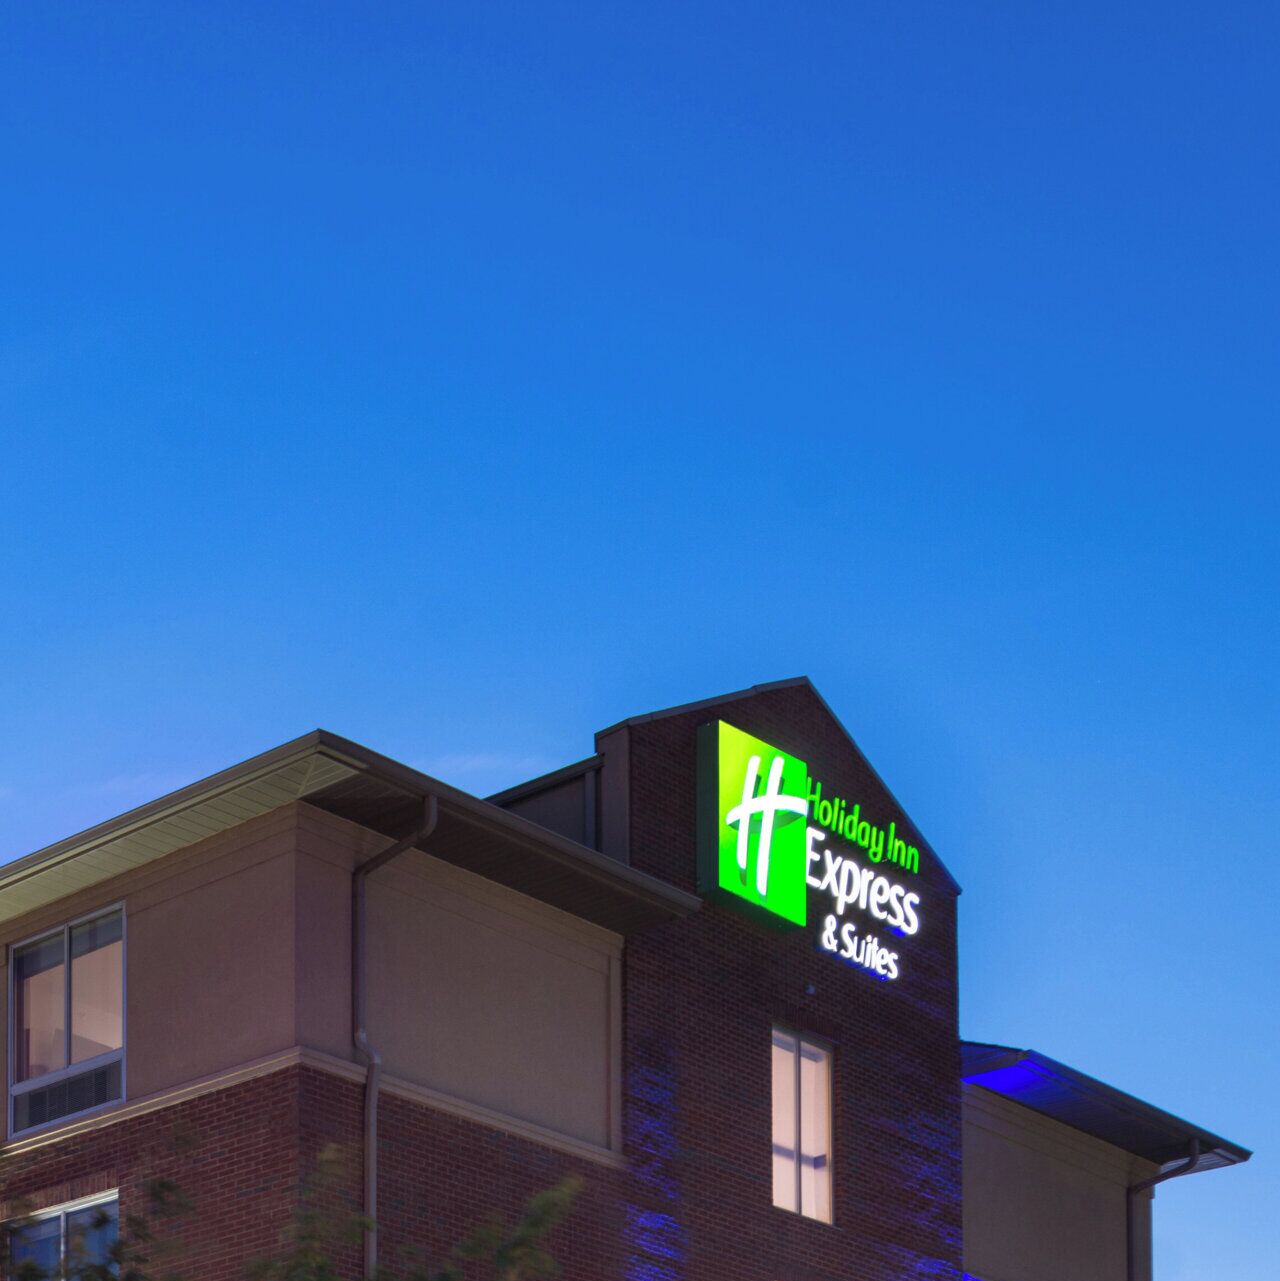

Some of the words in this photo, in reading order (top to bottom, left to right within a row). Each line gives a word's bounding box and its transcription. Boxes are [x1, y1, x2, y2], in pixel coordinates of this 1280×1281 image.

[807, 776, 884, 863] Holiday
[887, 822, 920, 874] Inn
[806, 827, 920, 936] Express
[822, 914, 838, 952] &
[841, 923, 899, 980] Suites
